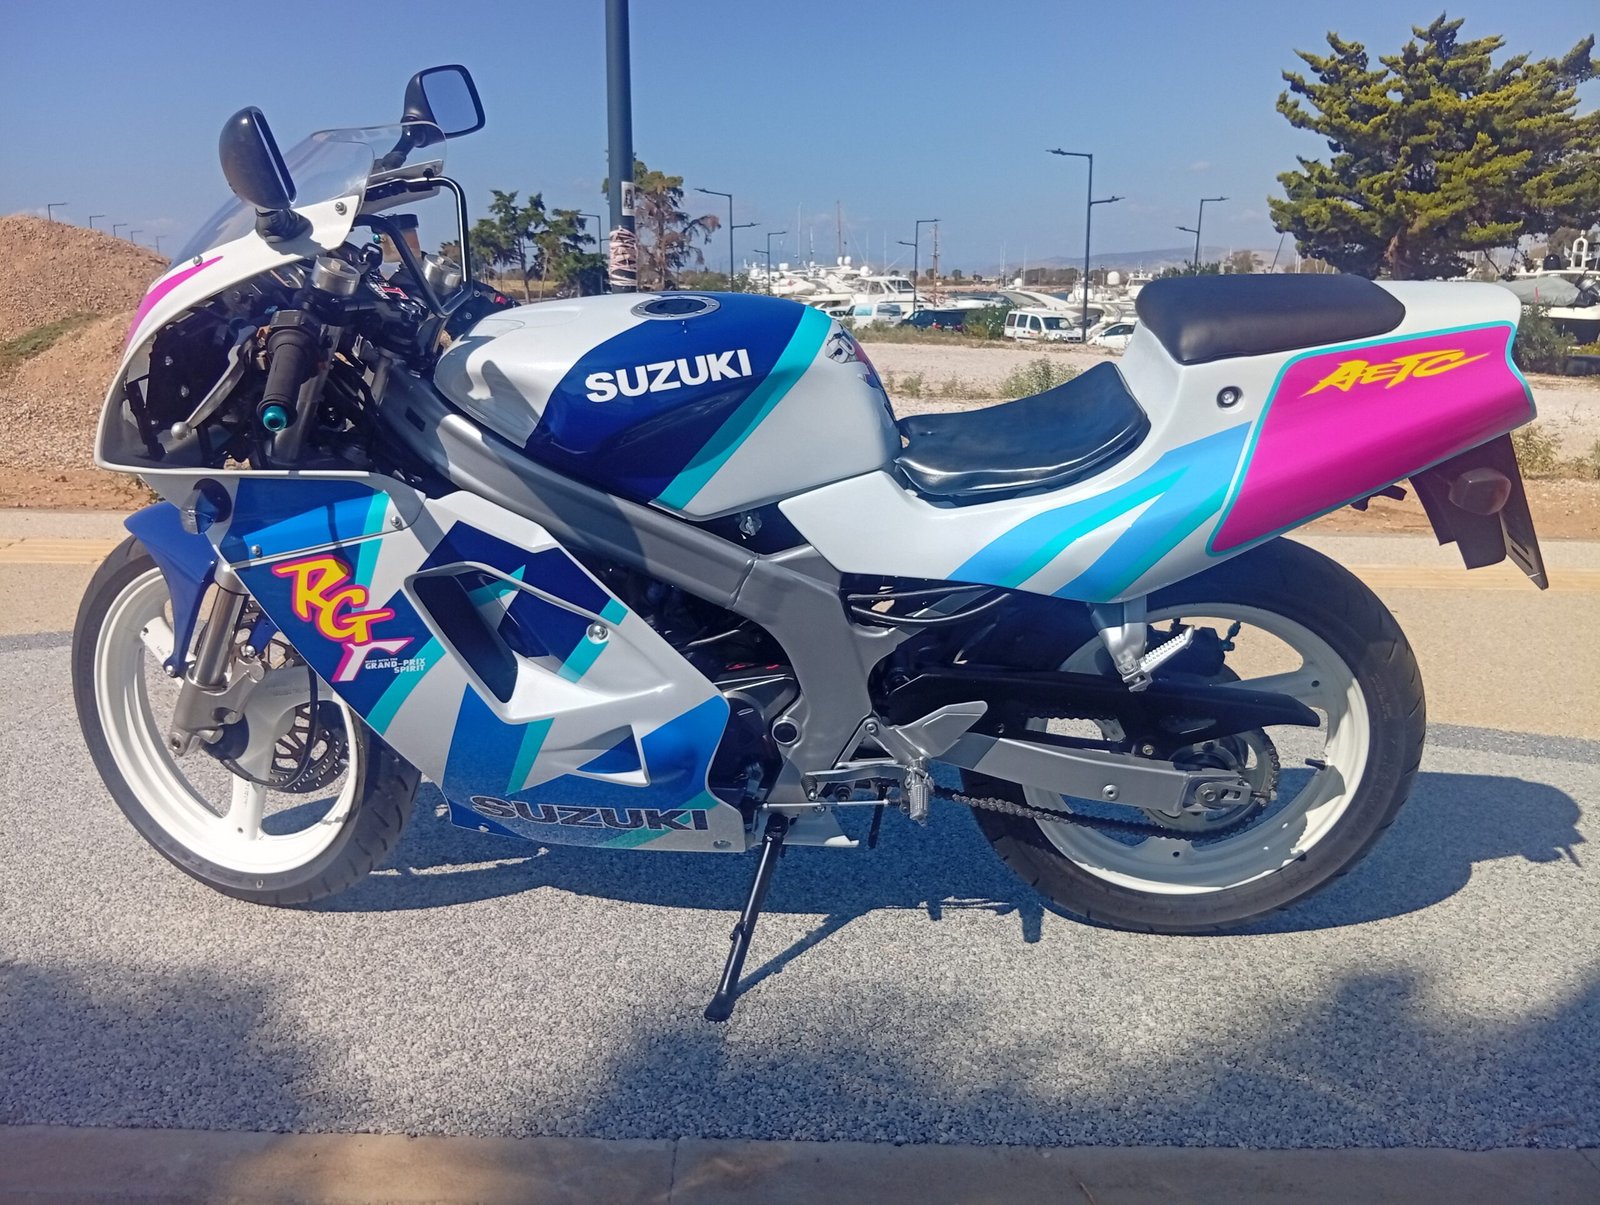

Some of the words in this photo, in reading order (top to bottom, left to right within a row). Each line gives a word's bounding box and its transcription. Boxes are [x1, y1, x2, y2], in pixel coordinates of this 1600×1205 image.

[585, 349, 752, 403] SUZUKI
[365, 658, 426, 670] GRAND-PRIX
[394, 665, 425, 674] SPIRIT
[470, 796, 708, 831] SUZUKI
